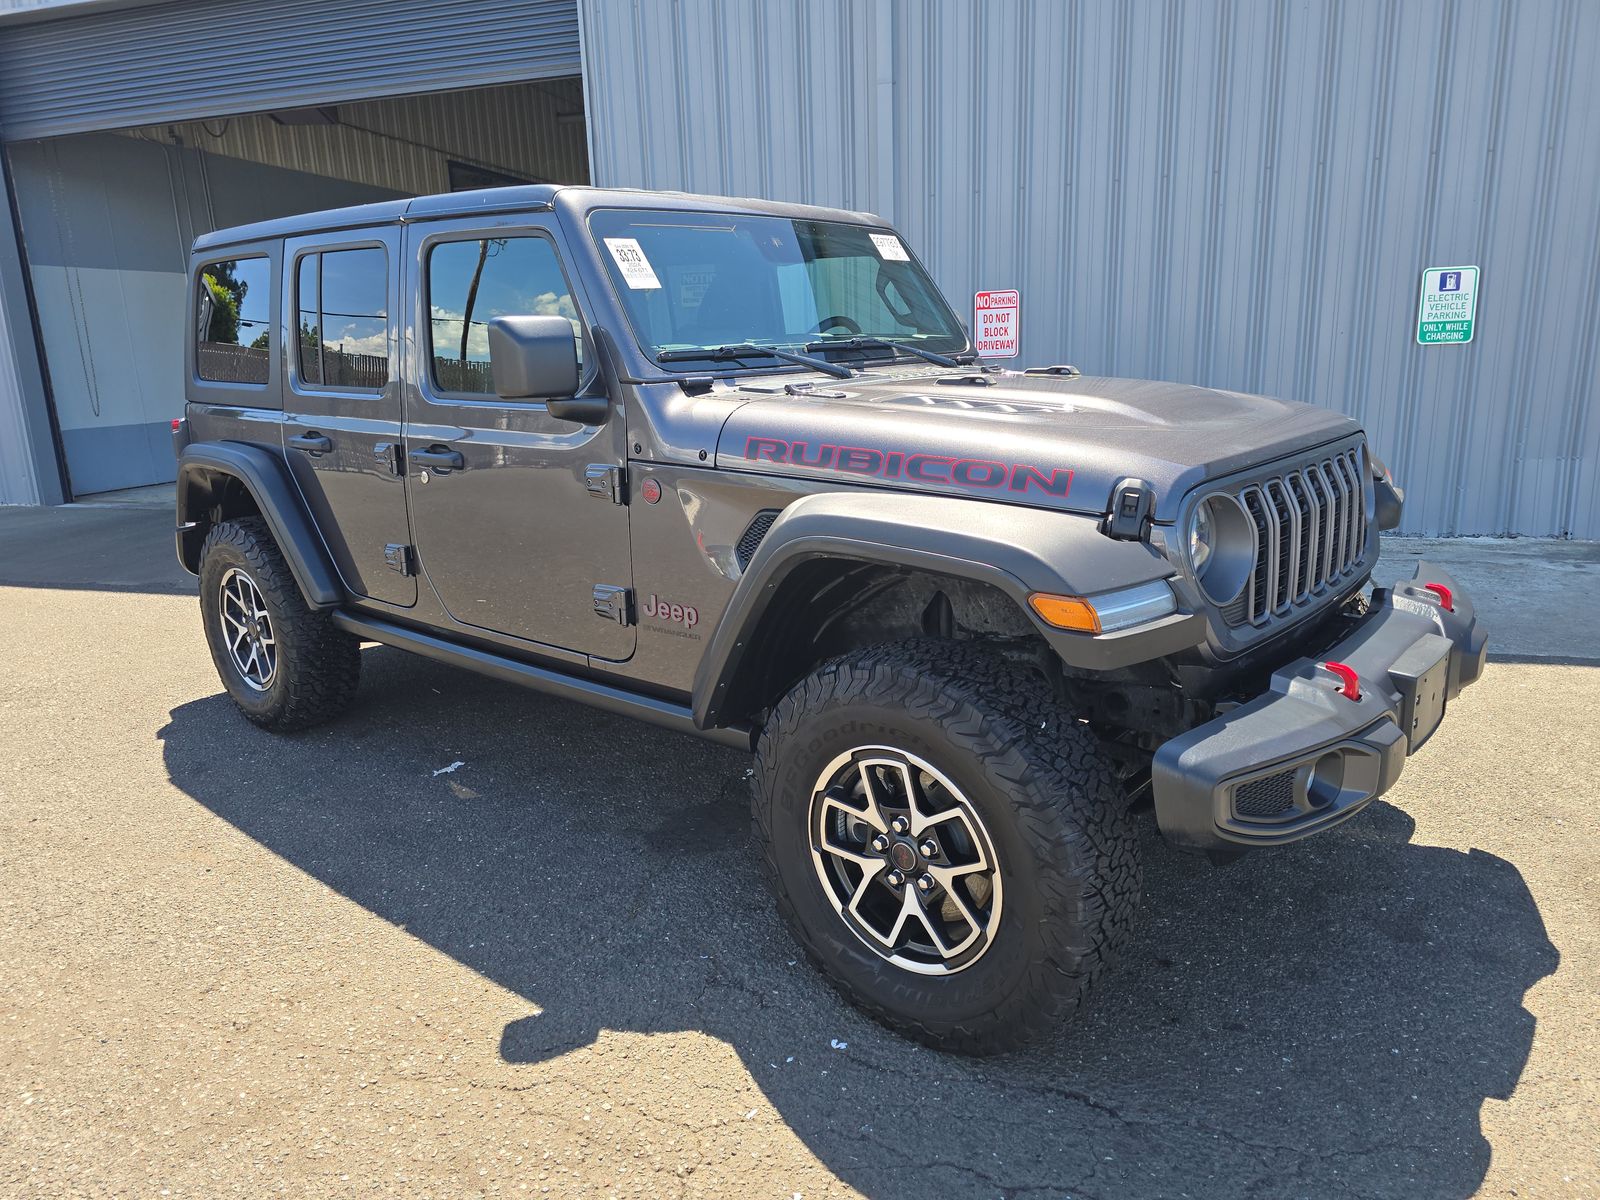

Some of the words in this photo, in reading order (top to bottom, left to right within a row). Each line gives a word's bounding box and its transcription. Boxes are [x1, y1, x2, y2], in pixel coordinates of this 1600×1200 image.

[616, 249, 641, 262] 33:73
[977, 296, 989, 308] NO
[991, 296, 1015, 305] PARKING
[1428, 293, 1469, 302] ELECTRIC
[1429, 302, 1466, 310] VEHICLE
[984, 314, 993, 323] DO
[996, 313, 1010, 323] NOT
[1427, 312, 1466, 320] PARKING
[985, 327, 1009, 337] BLOCK
[1423, 323, 1443, 331] ONLY
[1446, 323, 1468, 331] WHILE
[1426, 332, 1464, 340] CHARGING
[978, 340, 1014, 350] DRIVEWAY
[744, 436, 1074, 497] RUBICON
[643, 594, 698, 629] Jeep
